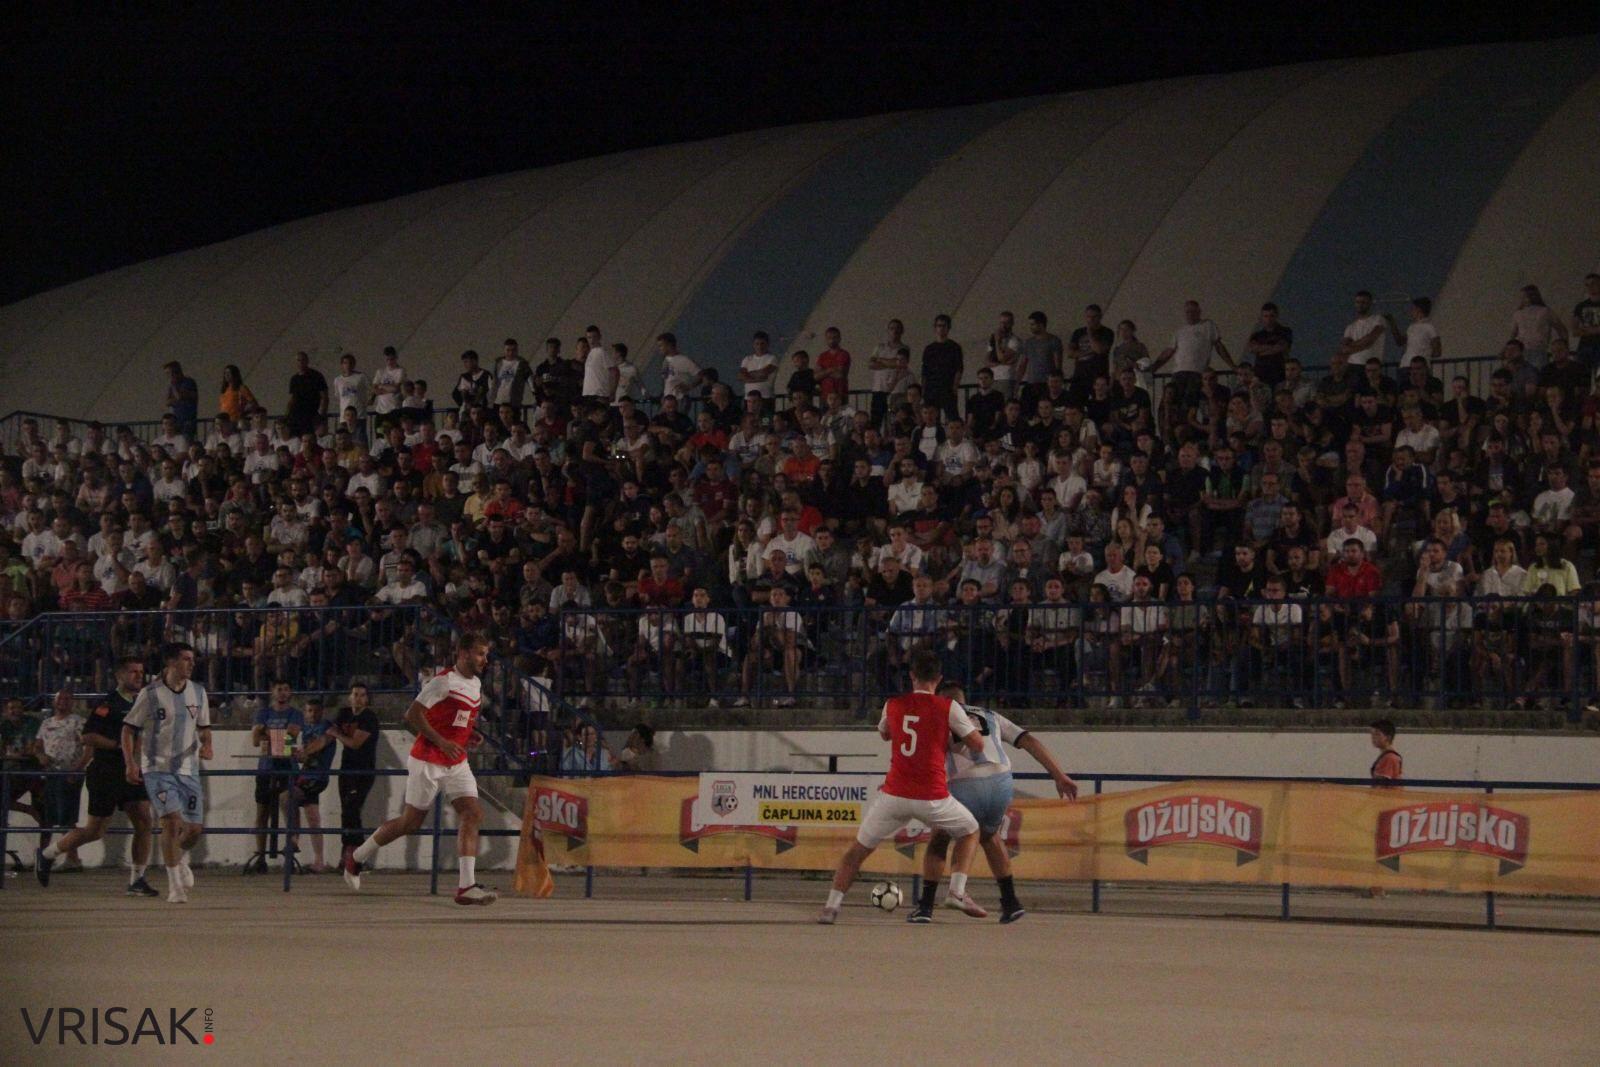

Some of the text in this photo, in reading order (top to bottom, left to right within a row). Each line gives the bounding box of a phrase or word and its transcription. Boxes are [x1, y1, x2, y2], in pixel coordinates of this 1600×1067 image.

[157, 708, 166, 721] 8
[900, 714, 920, 757] 5
[753, 785, 868, 801] MNL HERCEGOVINE
[188, 795, 197, 810] 8
[763, 805, 857, 821] ČAPLJINA 2021
[1137, 797, 1251, 843] Ožujsko
[1389, 804, 1517, 851] Ožujsko
